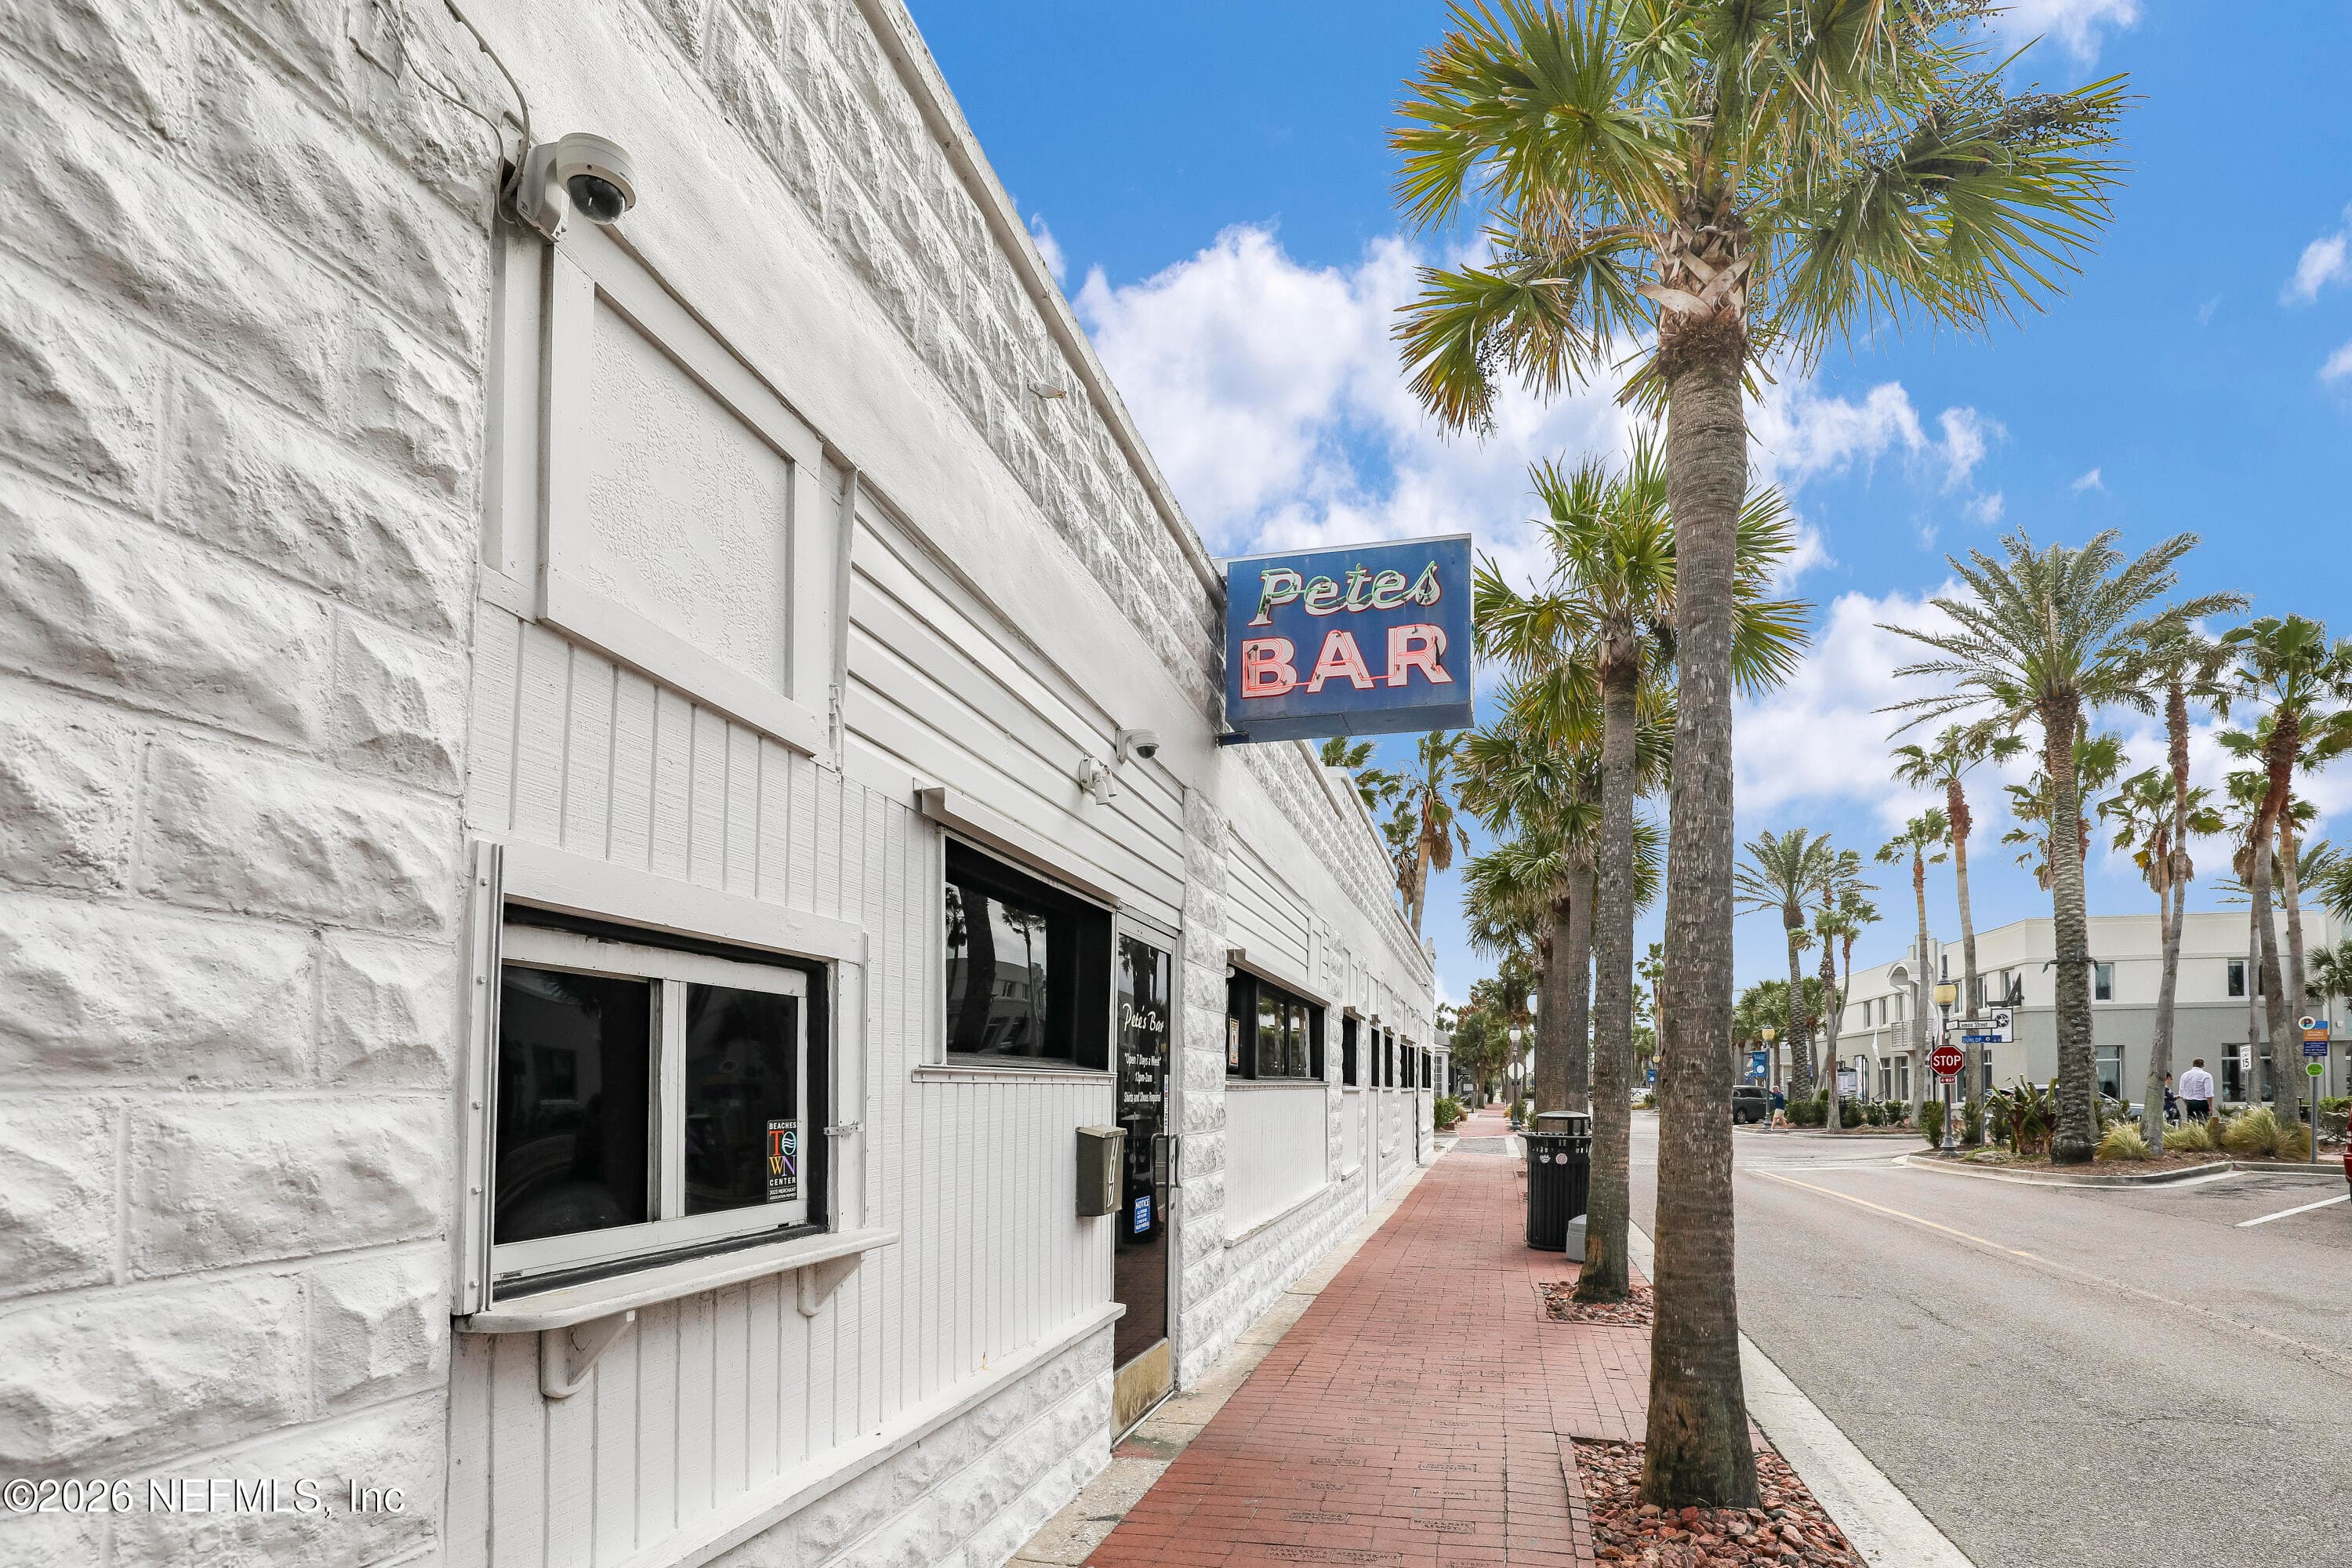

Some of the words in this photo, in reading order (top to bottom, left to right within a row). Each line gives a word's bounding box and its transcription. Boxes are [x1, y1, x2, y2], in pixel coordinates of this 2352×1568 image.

[1248, 561, 1440, 626] Petes
[1241, 624, 1453, 699] BAR
[1123, 1003, 1146, 1032] Pete's
[1148, 1011, 1163, 1033] Bar
[1139, 1054, 1148, 1068] Days
[1933, 1055, 1962, 1066] STOP
[2242, 1058, 2249, 1067] 15
[1123, 1091, 1134, 1102] Shirts
[1140, 1091, 1149, 1102] Shoes
[1149, 1091, 1161, 1105] Required
[769, 1177, 796, 1186] CENTER
[1135, 1199, 1149, 1210] NOTICE
